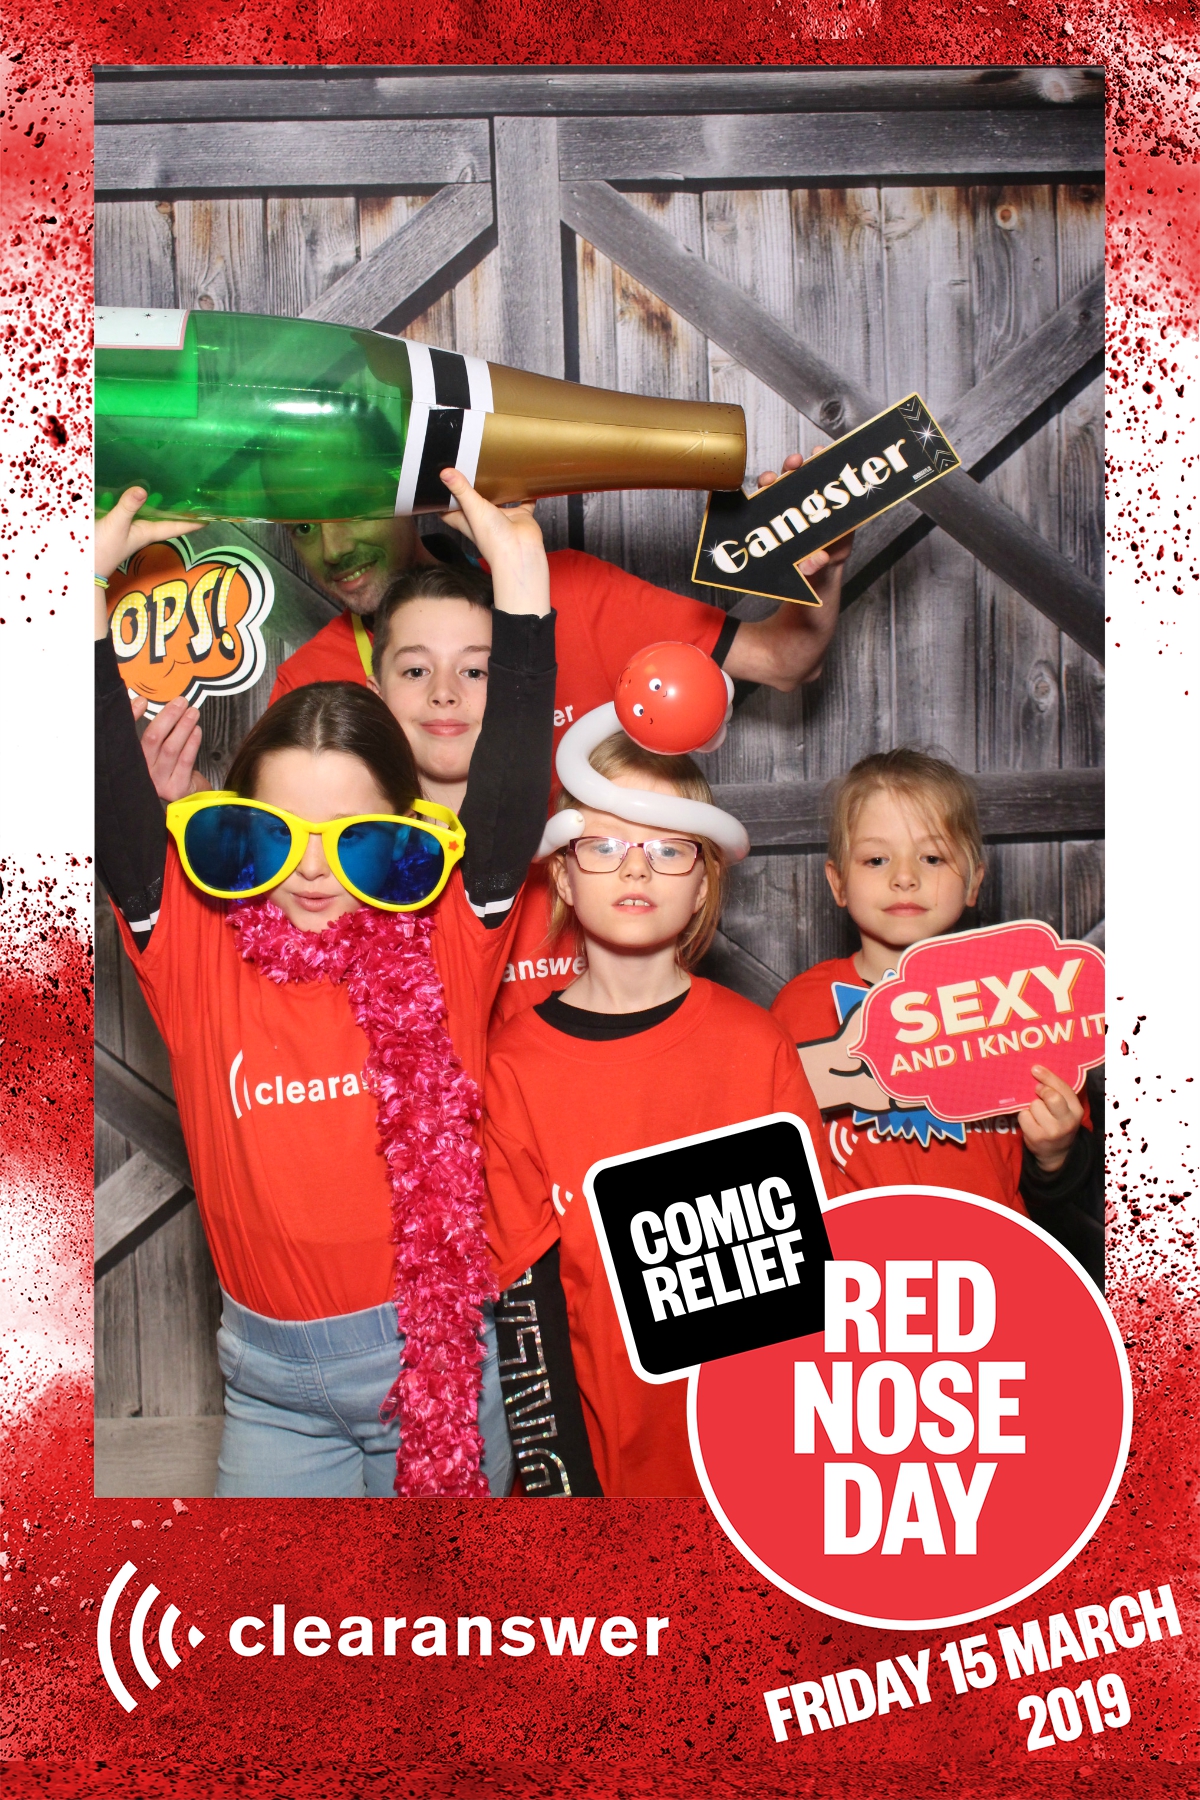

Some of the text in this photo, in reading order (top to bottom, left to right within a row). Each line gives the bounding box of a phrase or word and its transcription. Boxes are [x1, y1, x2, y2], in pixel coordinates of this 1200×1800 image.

[713, 438, 909, 574] Gangster
[889, 957, 1085, 1045] SEXY
[890, 1012, 1105, 1077] AND I KNOW IT
